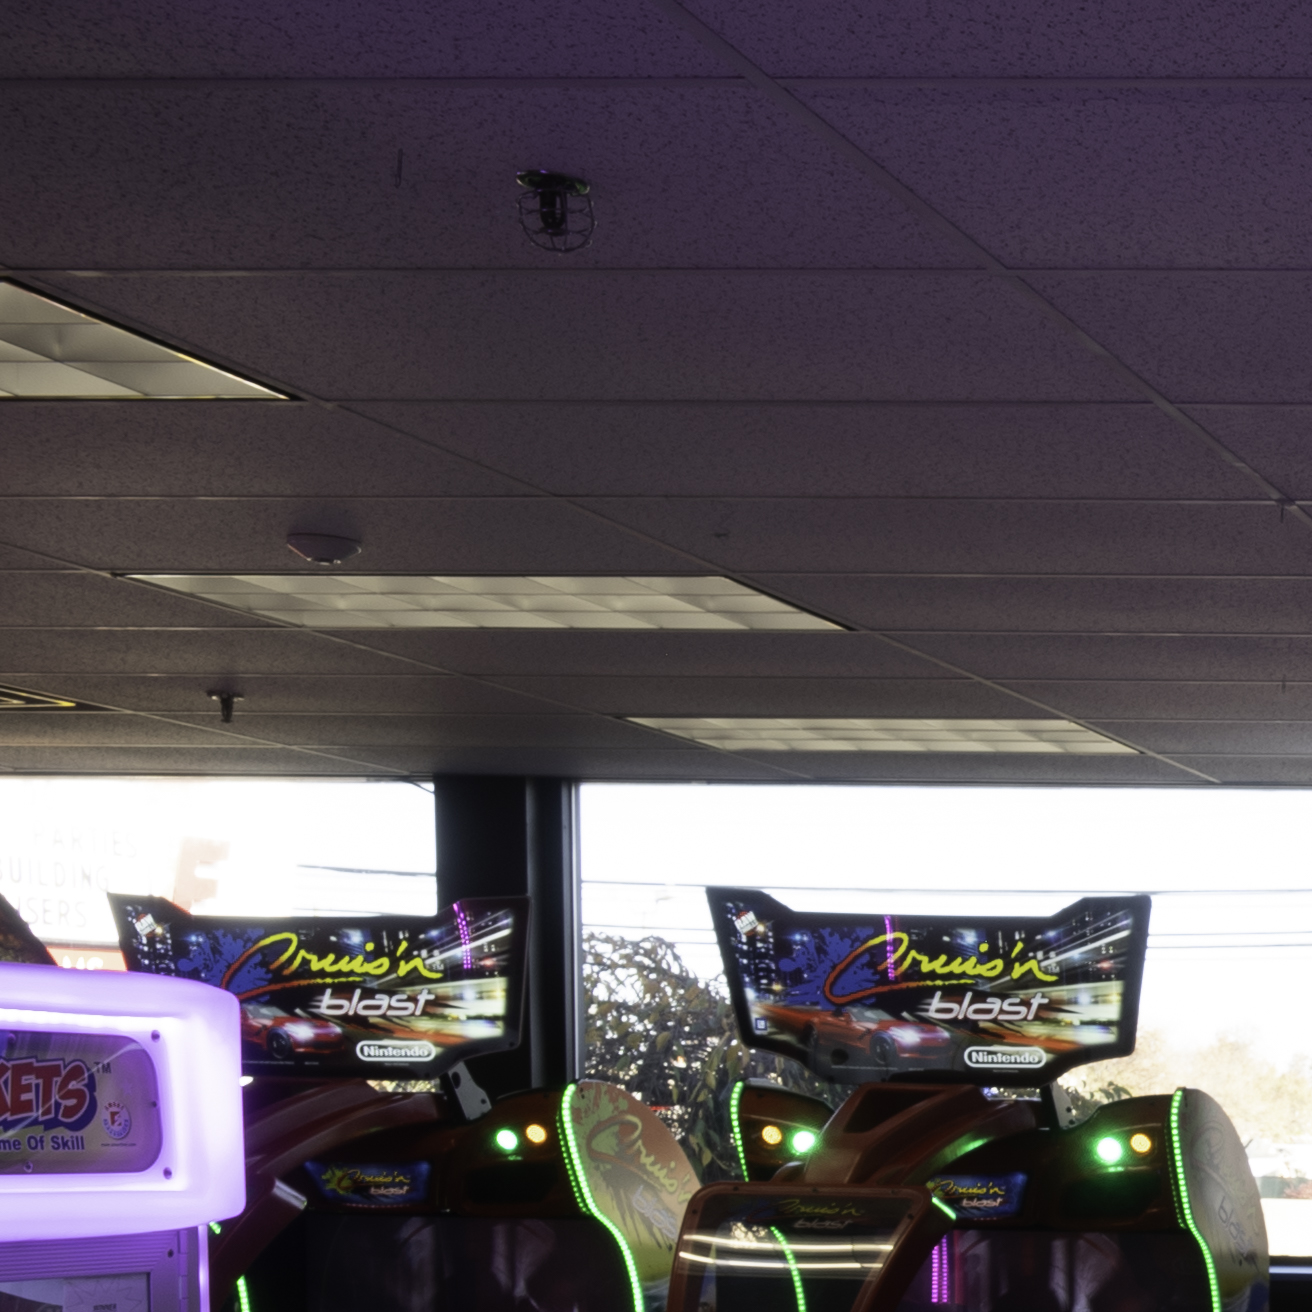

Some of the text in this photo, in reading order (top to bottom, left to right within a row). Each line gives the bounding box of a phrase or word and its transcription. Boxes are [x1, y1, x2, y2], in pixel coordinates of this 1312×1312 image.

[0, 856, 108, 893] UILDING
[317, 988, 437, 1017] blast
[928, 991, 1050, 1021] blast
[363, 1044, 431, 1058] Nintendo
[971, 1051, 1040, 1065] Nintendo
[27, 1135, 44, 1150] Of
[51, 1135, 84, 1151] Skill
[794, 1217, 852, 1230] blast
